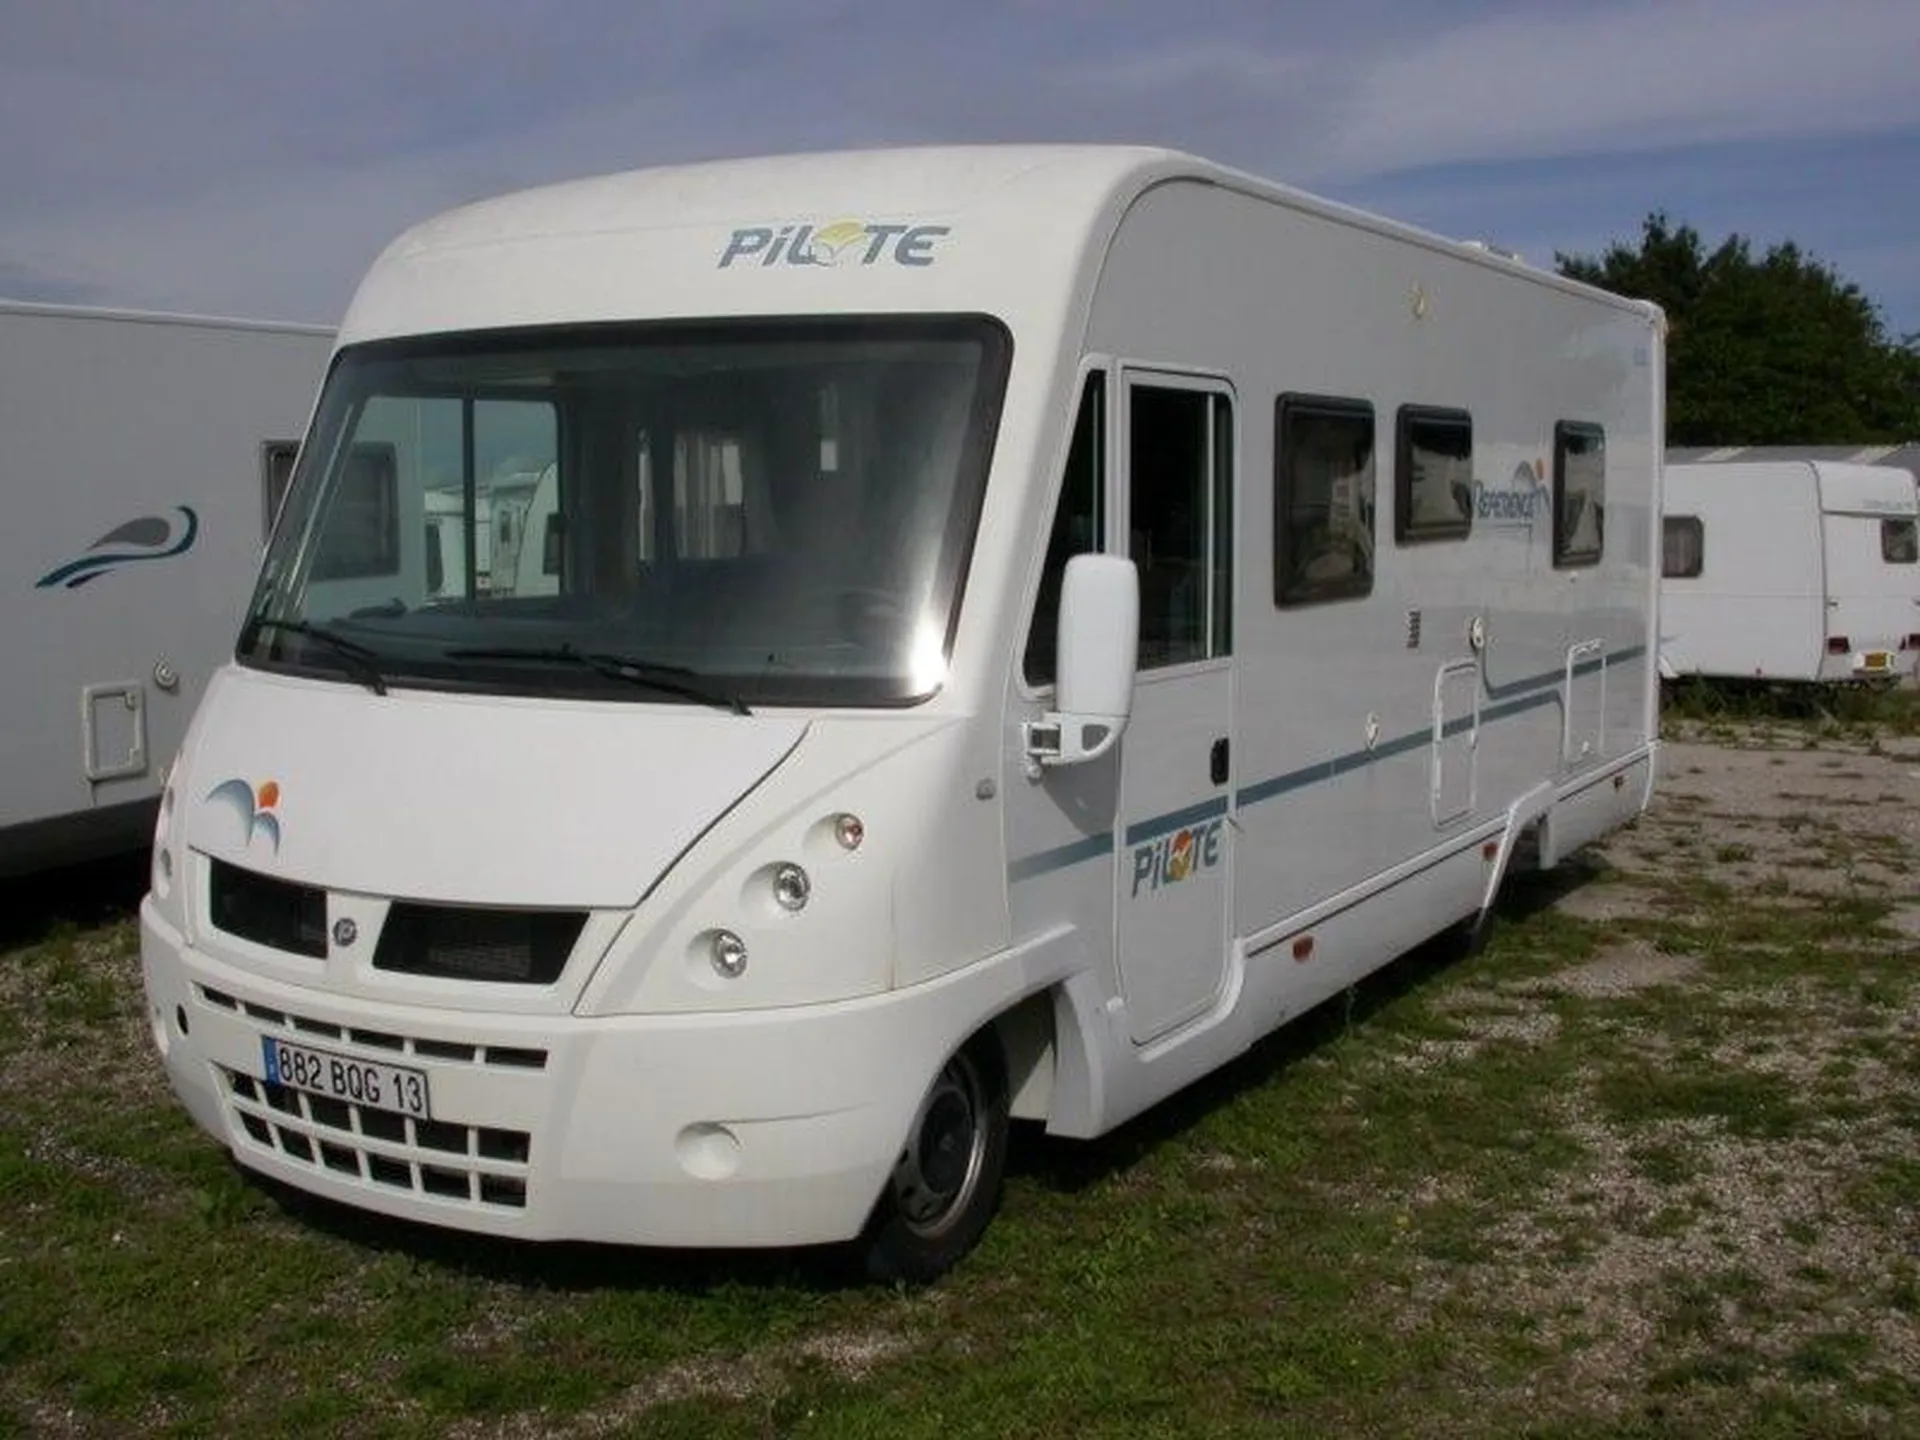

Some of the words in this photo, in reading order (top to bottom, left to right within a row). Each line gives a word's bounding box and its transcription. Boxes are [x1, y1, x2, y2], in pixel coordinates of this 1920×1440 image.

[279, 1047, 324, 1091] 882
[331, 1060, 381, 1103] BQG
[393, 1073, 423, 1113] 13
